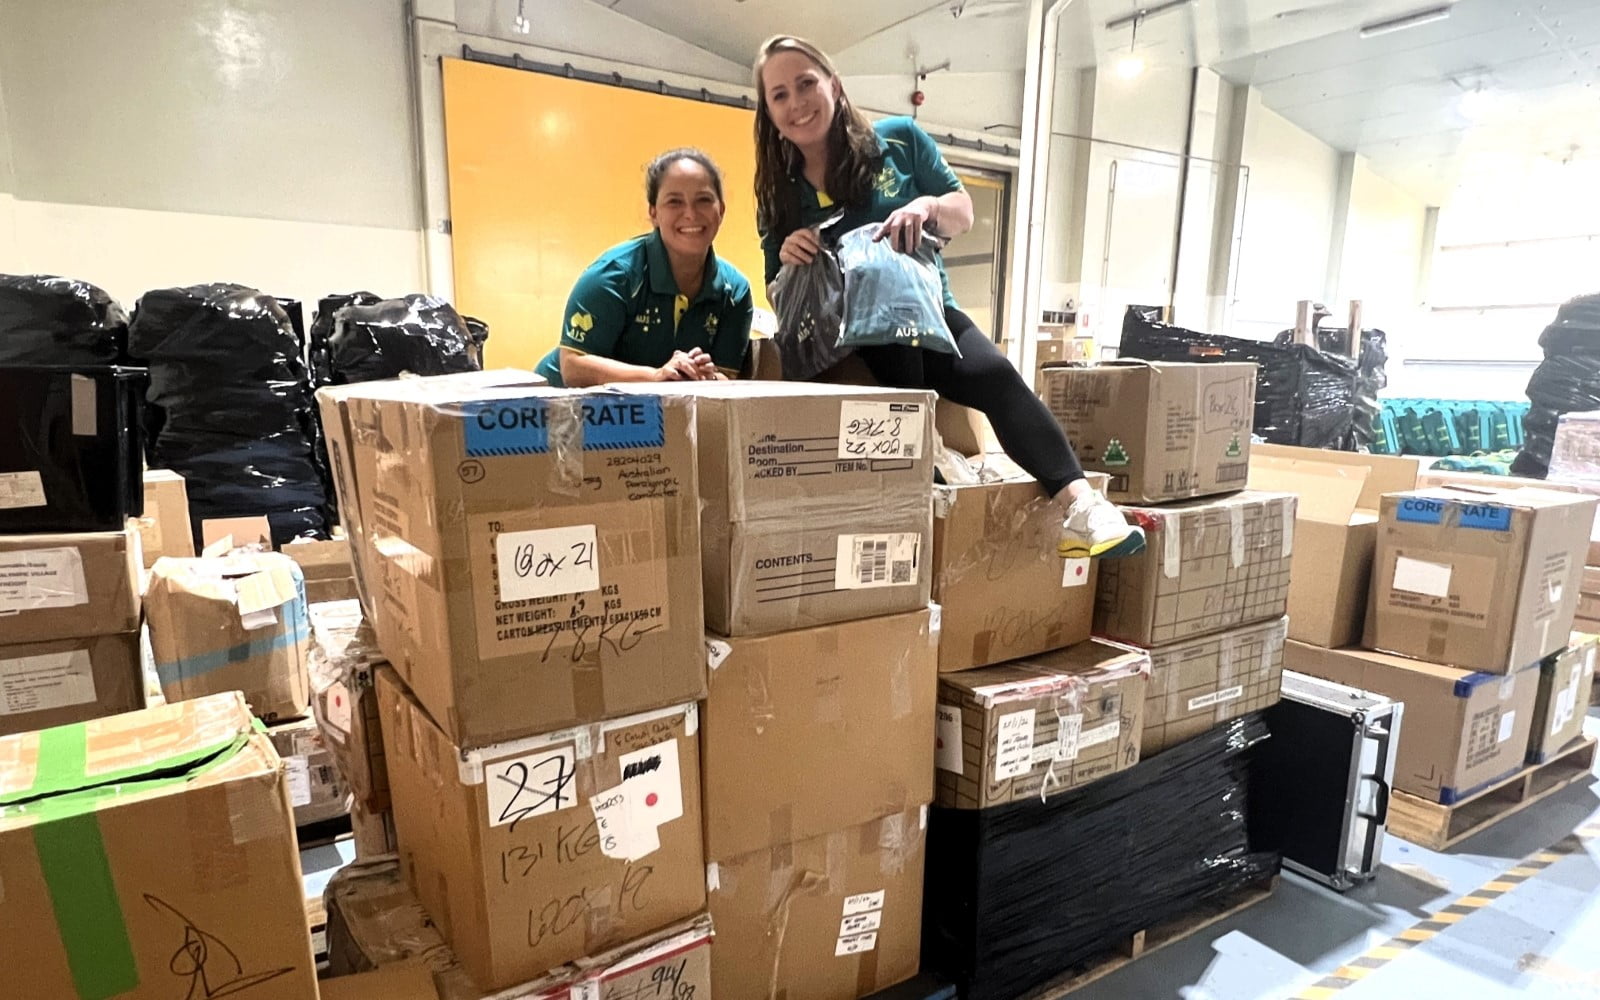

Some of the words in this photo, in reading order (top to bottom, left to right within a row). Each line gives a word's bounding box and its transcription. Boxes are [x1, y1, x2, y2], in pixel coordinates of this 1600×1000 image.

[895, 327, 918, 337] AUS
[748, 443, 805, 456] Destination
[618, 466, 671, 480] Australian
[785, 466, 798, 477] BY
[835, 462, 854, 473] ITEM
[488, 521, 505, 533] TO:
[570, 541, 594, 571] 21
[755, 553, 814, 570] CONTENTS
[601, 584, 619, 597] KGS
[495, 613, 515, 626] NET
[516, 607, 556, 623] WEIGHT:
[604, 597, 622, 611] KGS
[497, 625, 534, 642] CARTON
